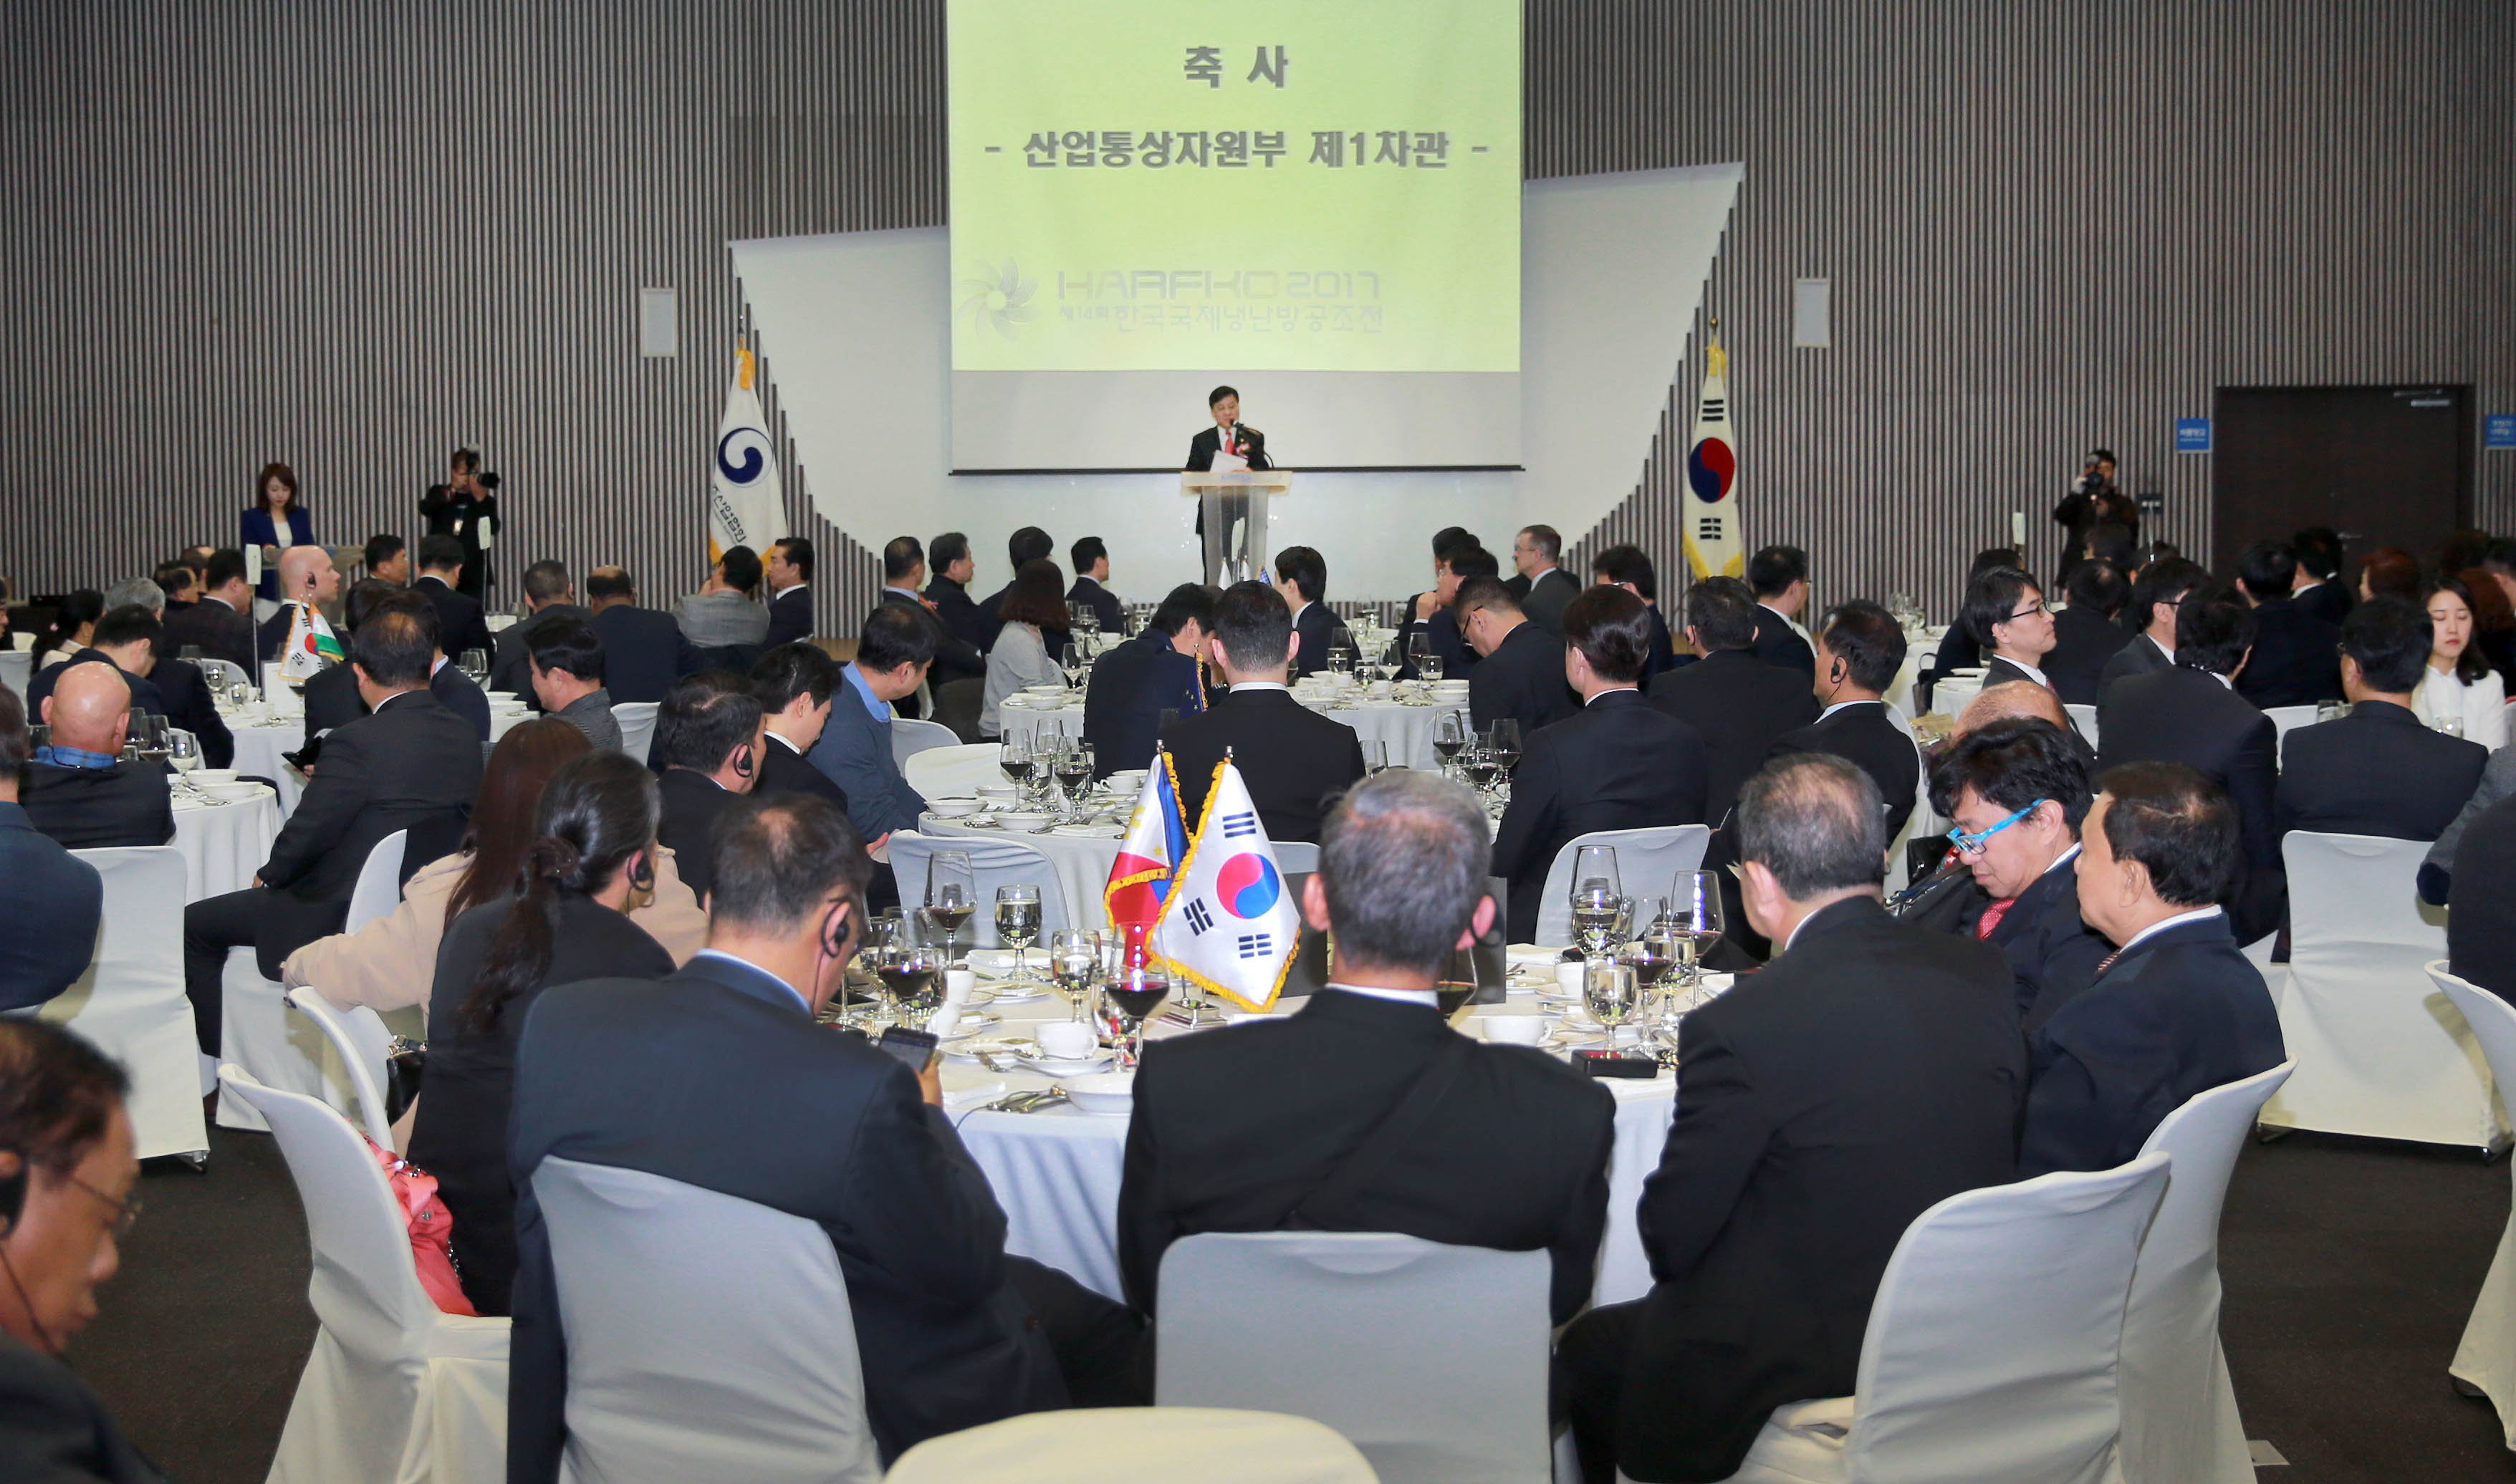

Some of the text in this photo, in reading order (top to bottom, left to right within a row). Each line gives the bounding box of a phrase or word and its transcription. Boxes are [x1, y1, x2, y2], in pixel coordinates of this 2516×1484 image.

[1183, 46, 1290, 89] 축 사
[1022, 131, 1287, 169] 산업통상자원부
[1309, 130, 1450, 169] 제1차관
[1057, 270, 1381, 300] HARFKO 2017
[1115, 304, 1384, 334] 한국국제냉난방공조전
